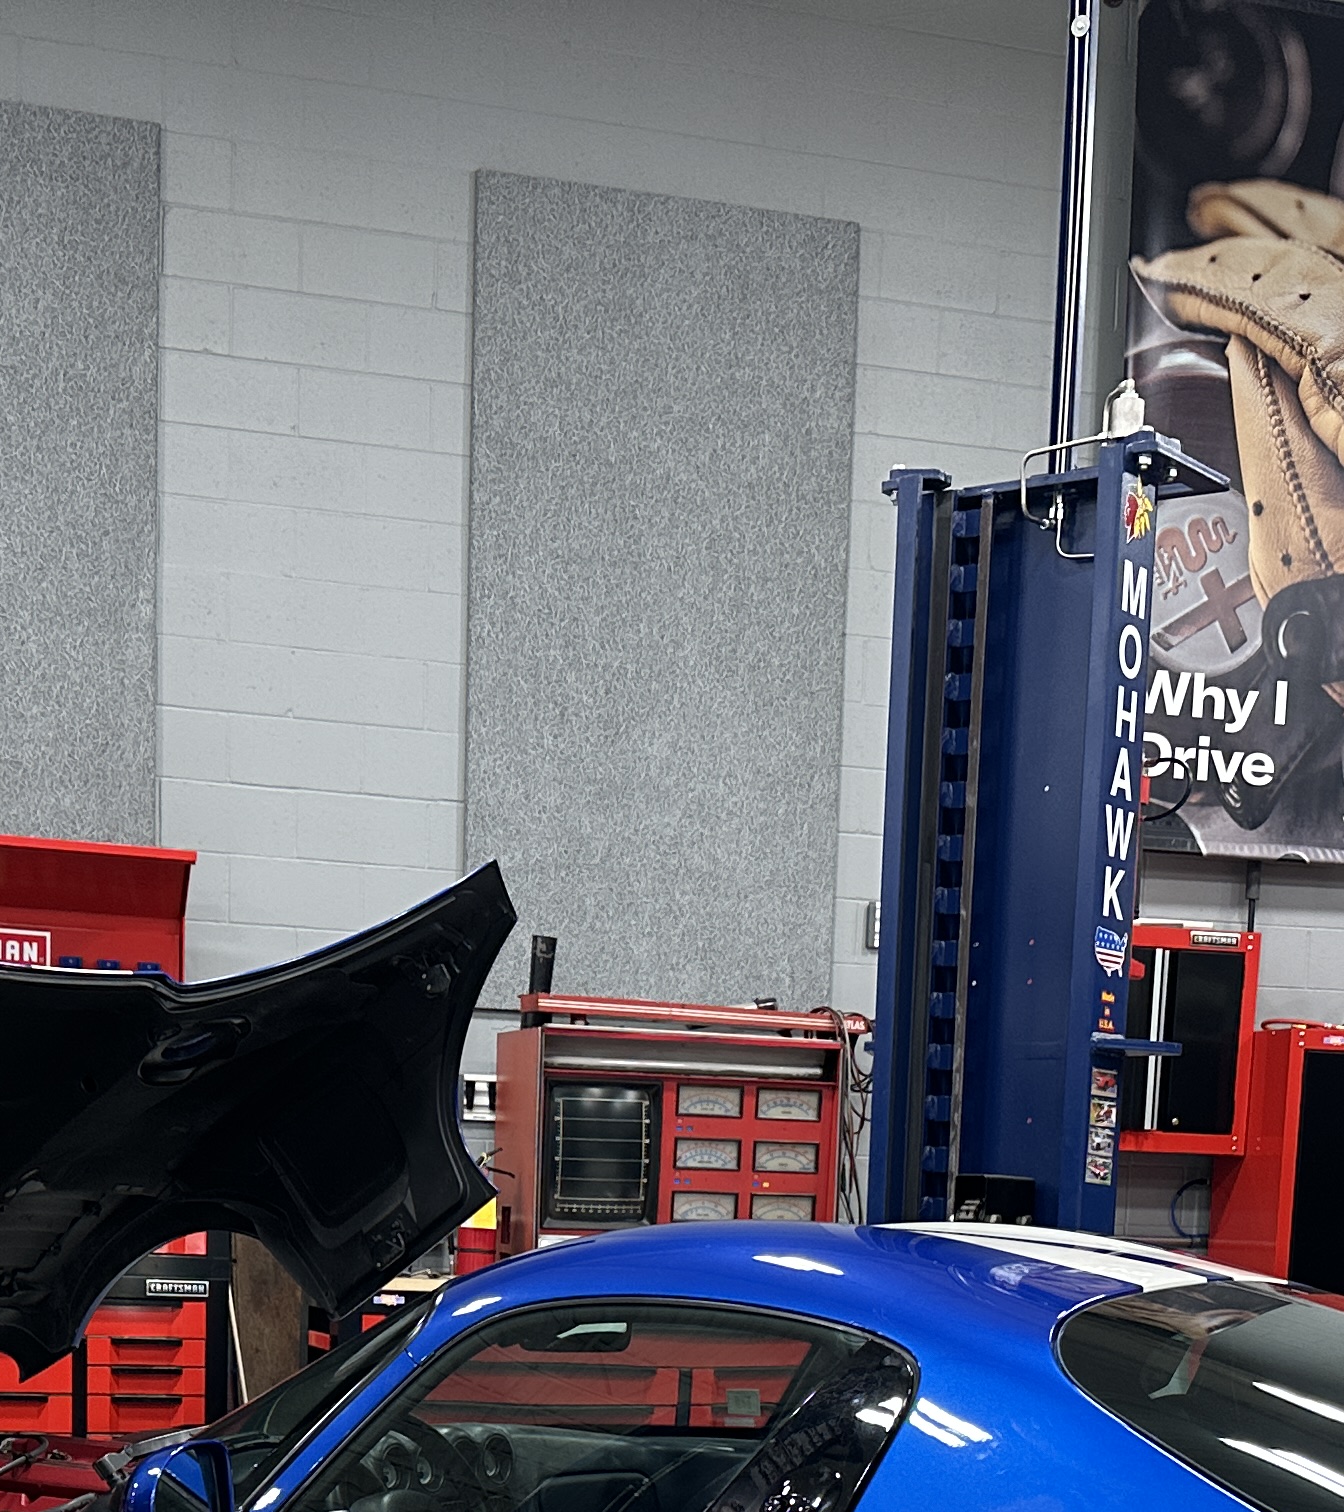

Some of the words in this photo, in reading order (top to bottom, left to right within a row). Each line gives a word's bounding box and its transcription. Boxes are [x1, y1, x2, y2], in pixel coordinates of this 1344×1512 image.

[1144, 669, 1259, 734] Why
[1274, 680, 1288, 726] I
[1103, 558, 1148, 921] MOHAWK
[1143, 731, 1275, 787] Drive
[1193, 935, 1238, 945] CRAFTSMAN
[149, 1283, 205, 1294] CRAFTSMAN
